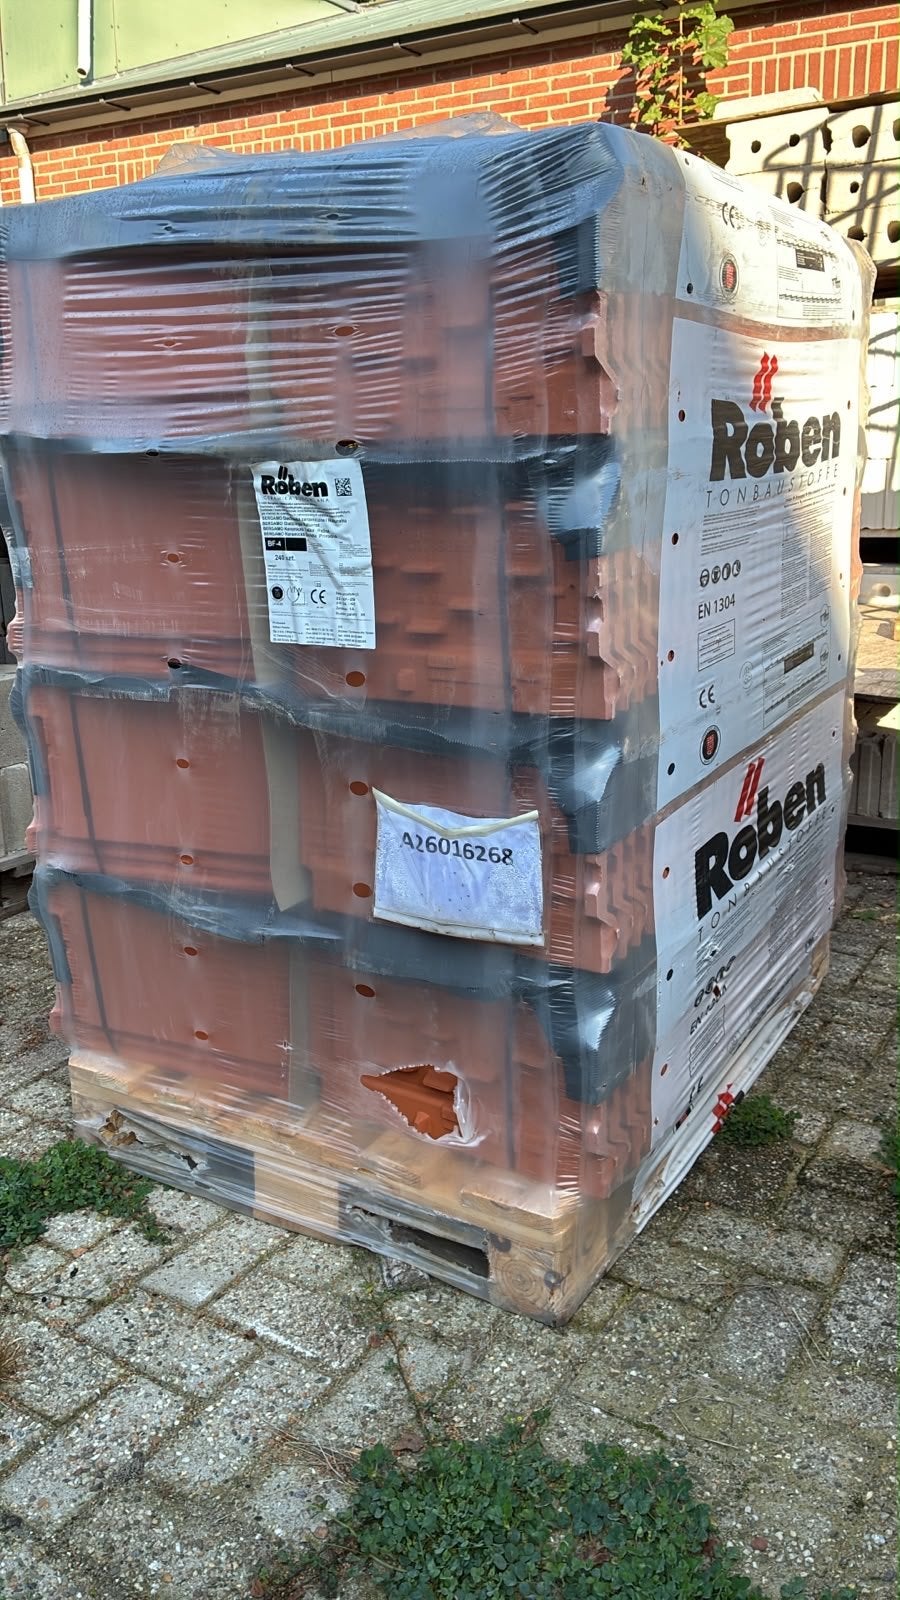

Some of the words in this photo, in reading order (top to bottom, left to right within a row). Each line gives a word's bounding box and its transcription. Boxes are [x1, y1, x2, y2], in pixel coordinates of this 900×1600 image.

[709, 351, 842, 482] Röben
[260, 465, 329, 497] Röben
[705, 463, 839, 509] TONBAUSTOFFE
[697, 602, 711, 620] EN
[714, 593, 736, 614] 1304
[400, 831, 514, 866] A26016268
[694, 757, 827, 921] Röben
